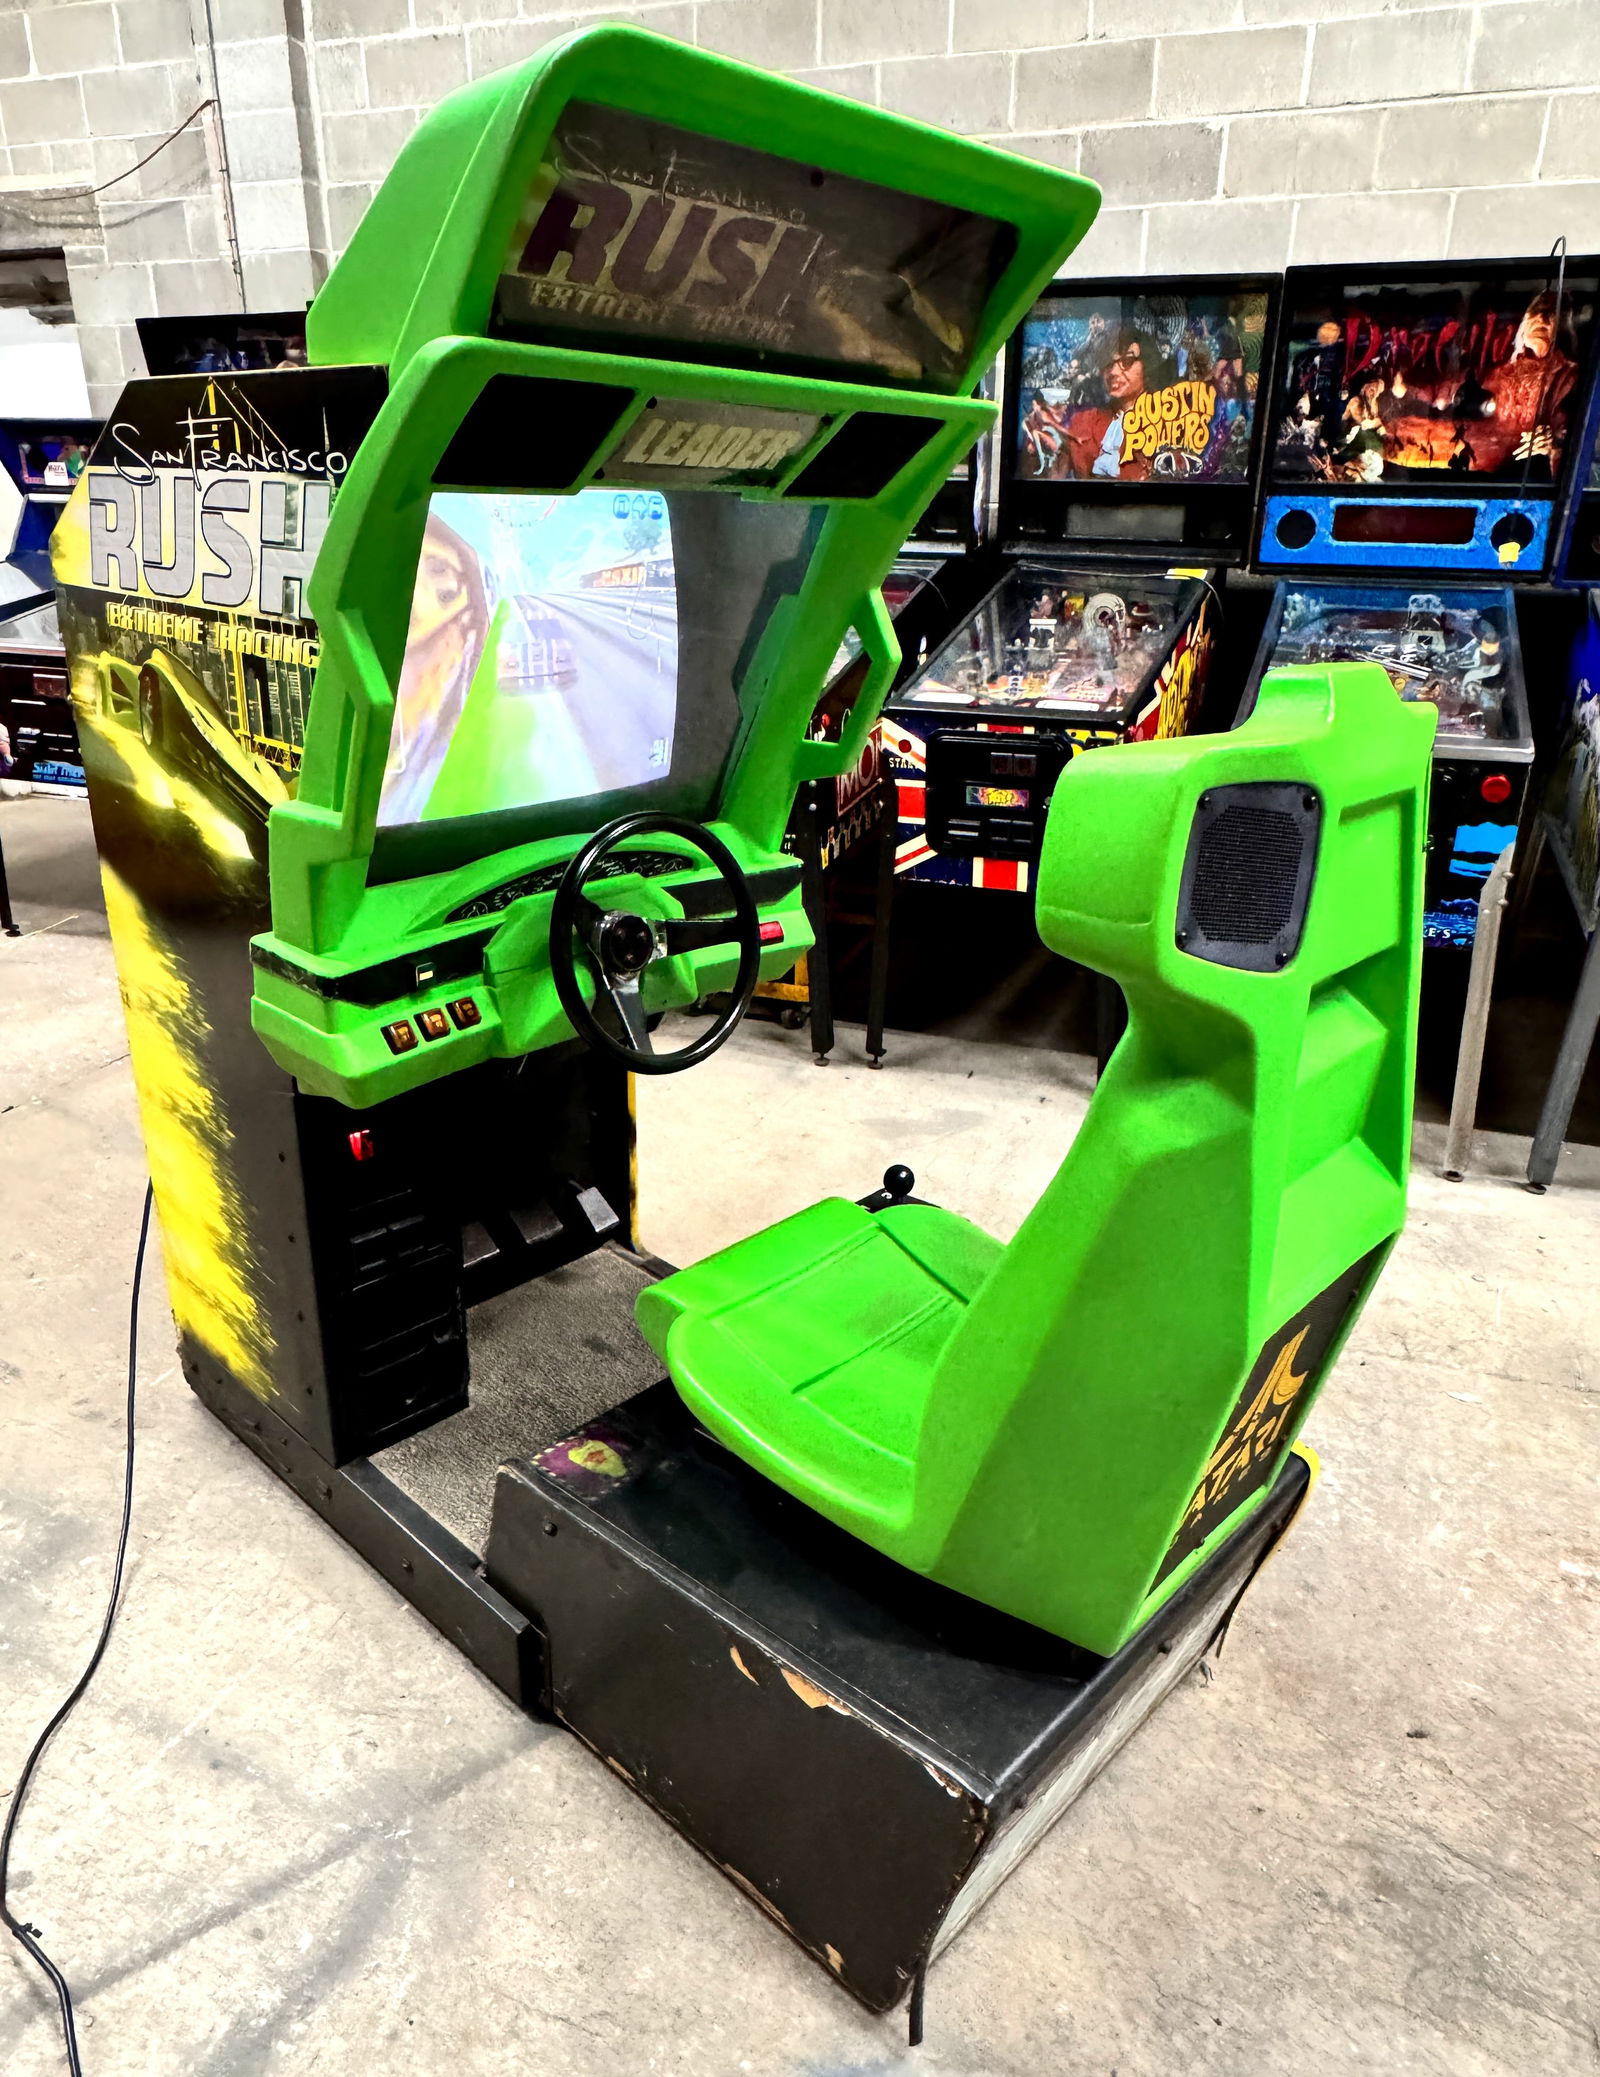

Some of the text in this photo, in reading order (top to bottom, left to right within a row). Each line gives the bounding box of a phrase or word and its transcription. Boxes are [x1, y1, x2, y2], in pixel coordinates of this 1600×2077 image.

[517, 177, 824, 318] RUSH
[1120, 411, 1210, 464] POWERS
[1123, 381, 1217, 434] AUSTIN
[622, 418, 801, 470] LEADER
[89, 473, 332, 620] RUSH
[106, 601, 320, 668] EXTREME RACING
[1170, 1402, 1292, 1548] ATARI
